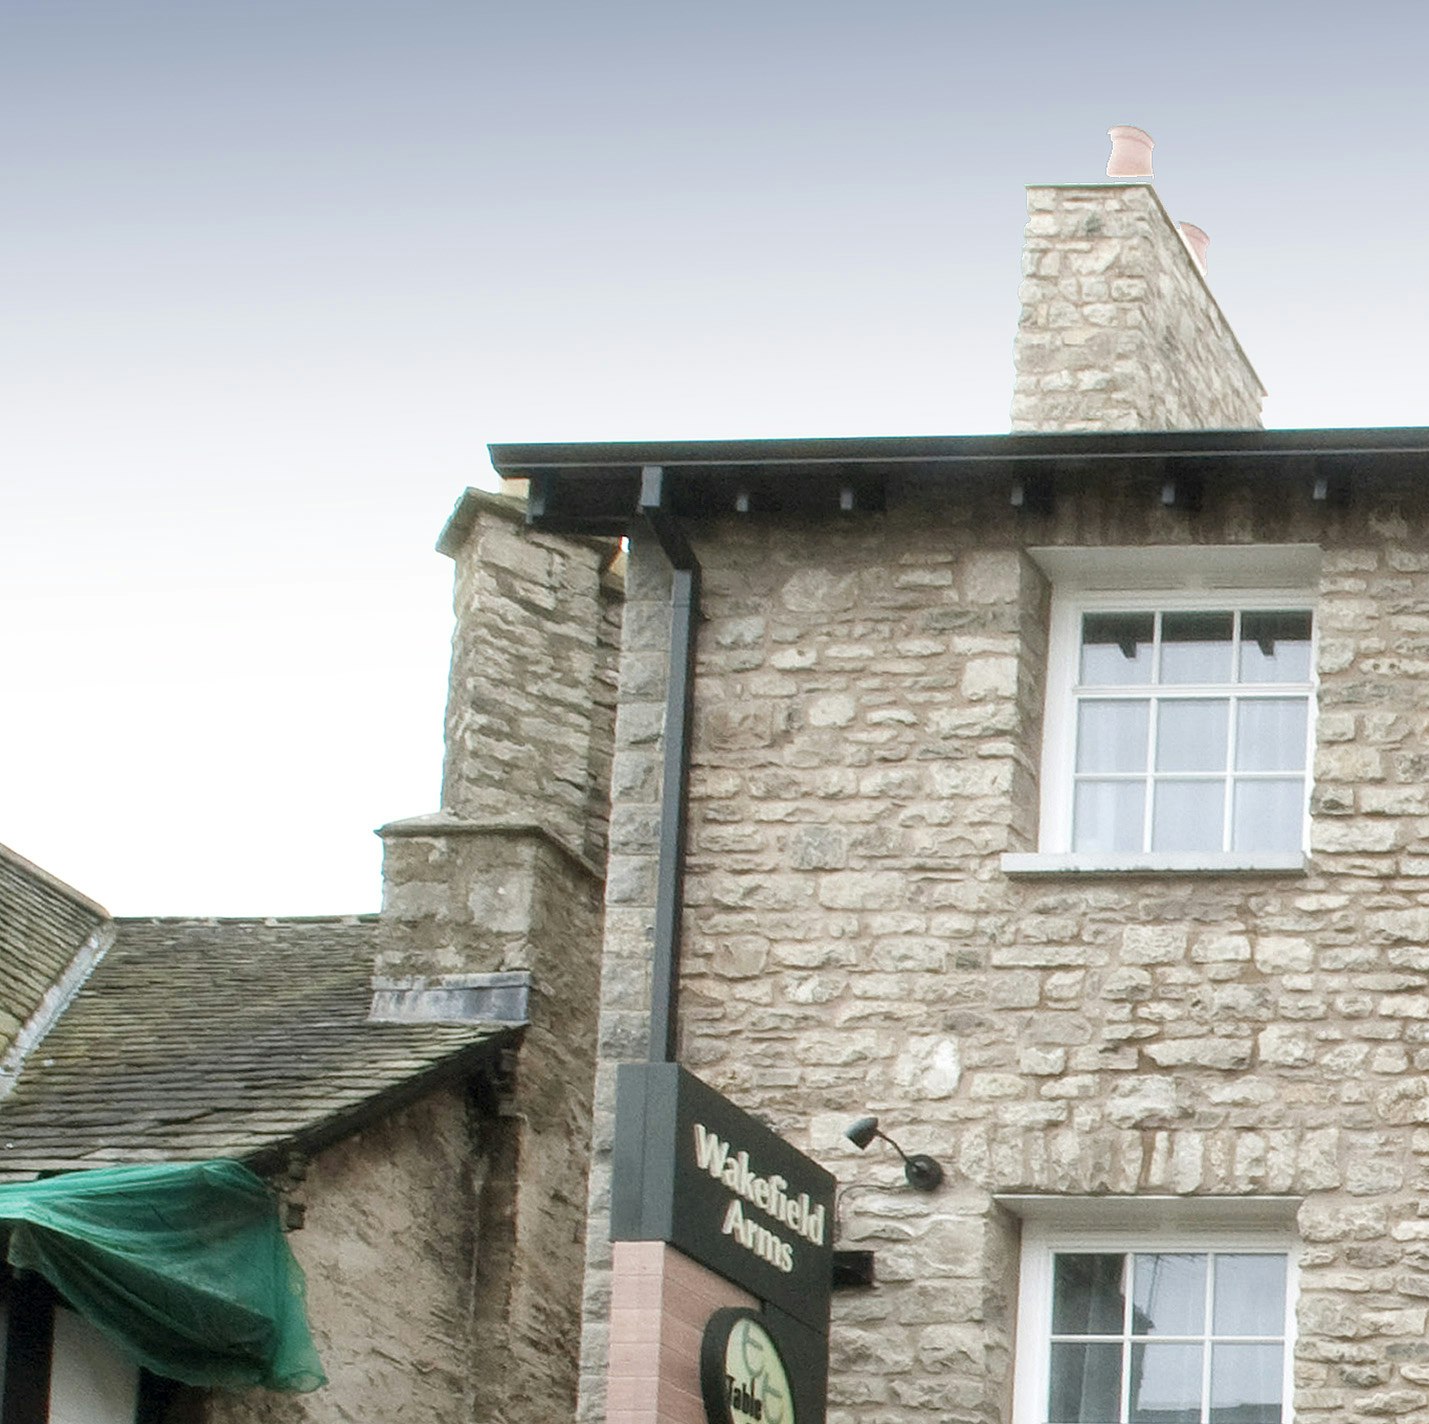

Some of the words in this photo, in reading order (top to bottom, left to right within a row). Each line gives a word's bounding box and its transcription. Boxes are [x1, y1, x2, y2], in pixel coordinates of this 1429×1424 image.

[694, 1124, 825, 1246] Wakefield
[722, 1199, 793, 1272] Arms
[725, 1375, 762, 1421] Table
